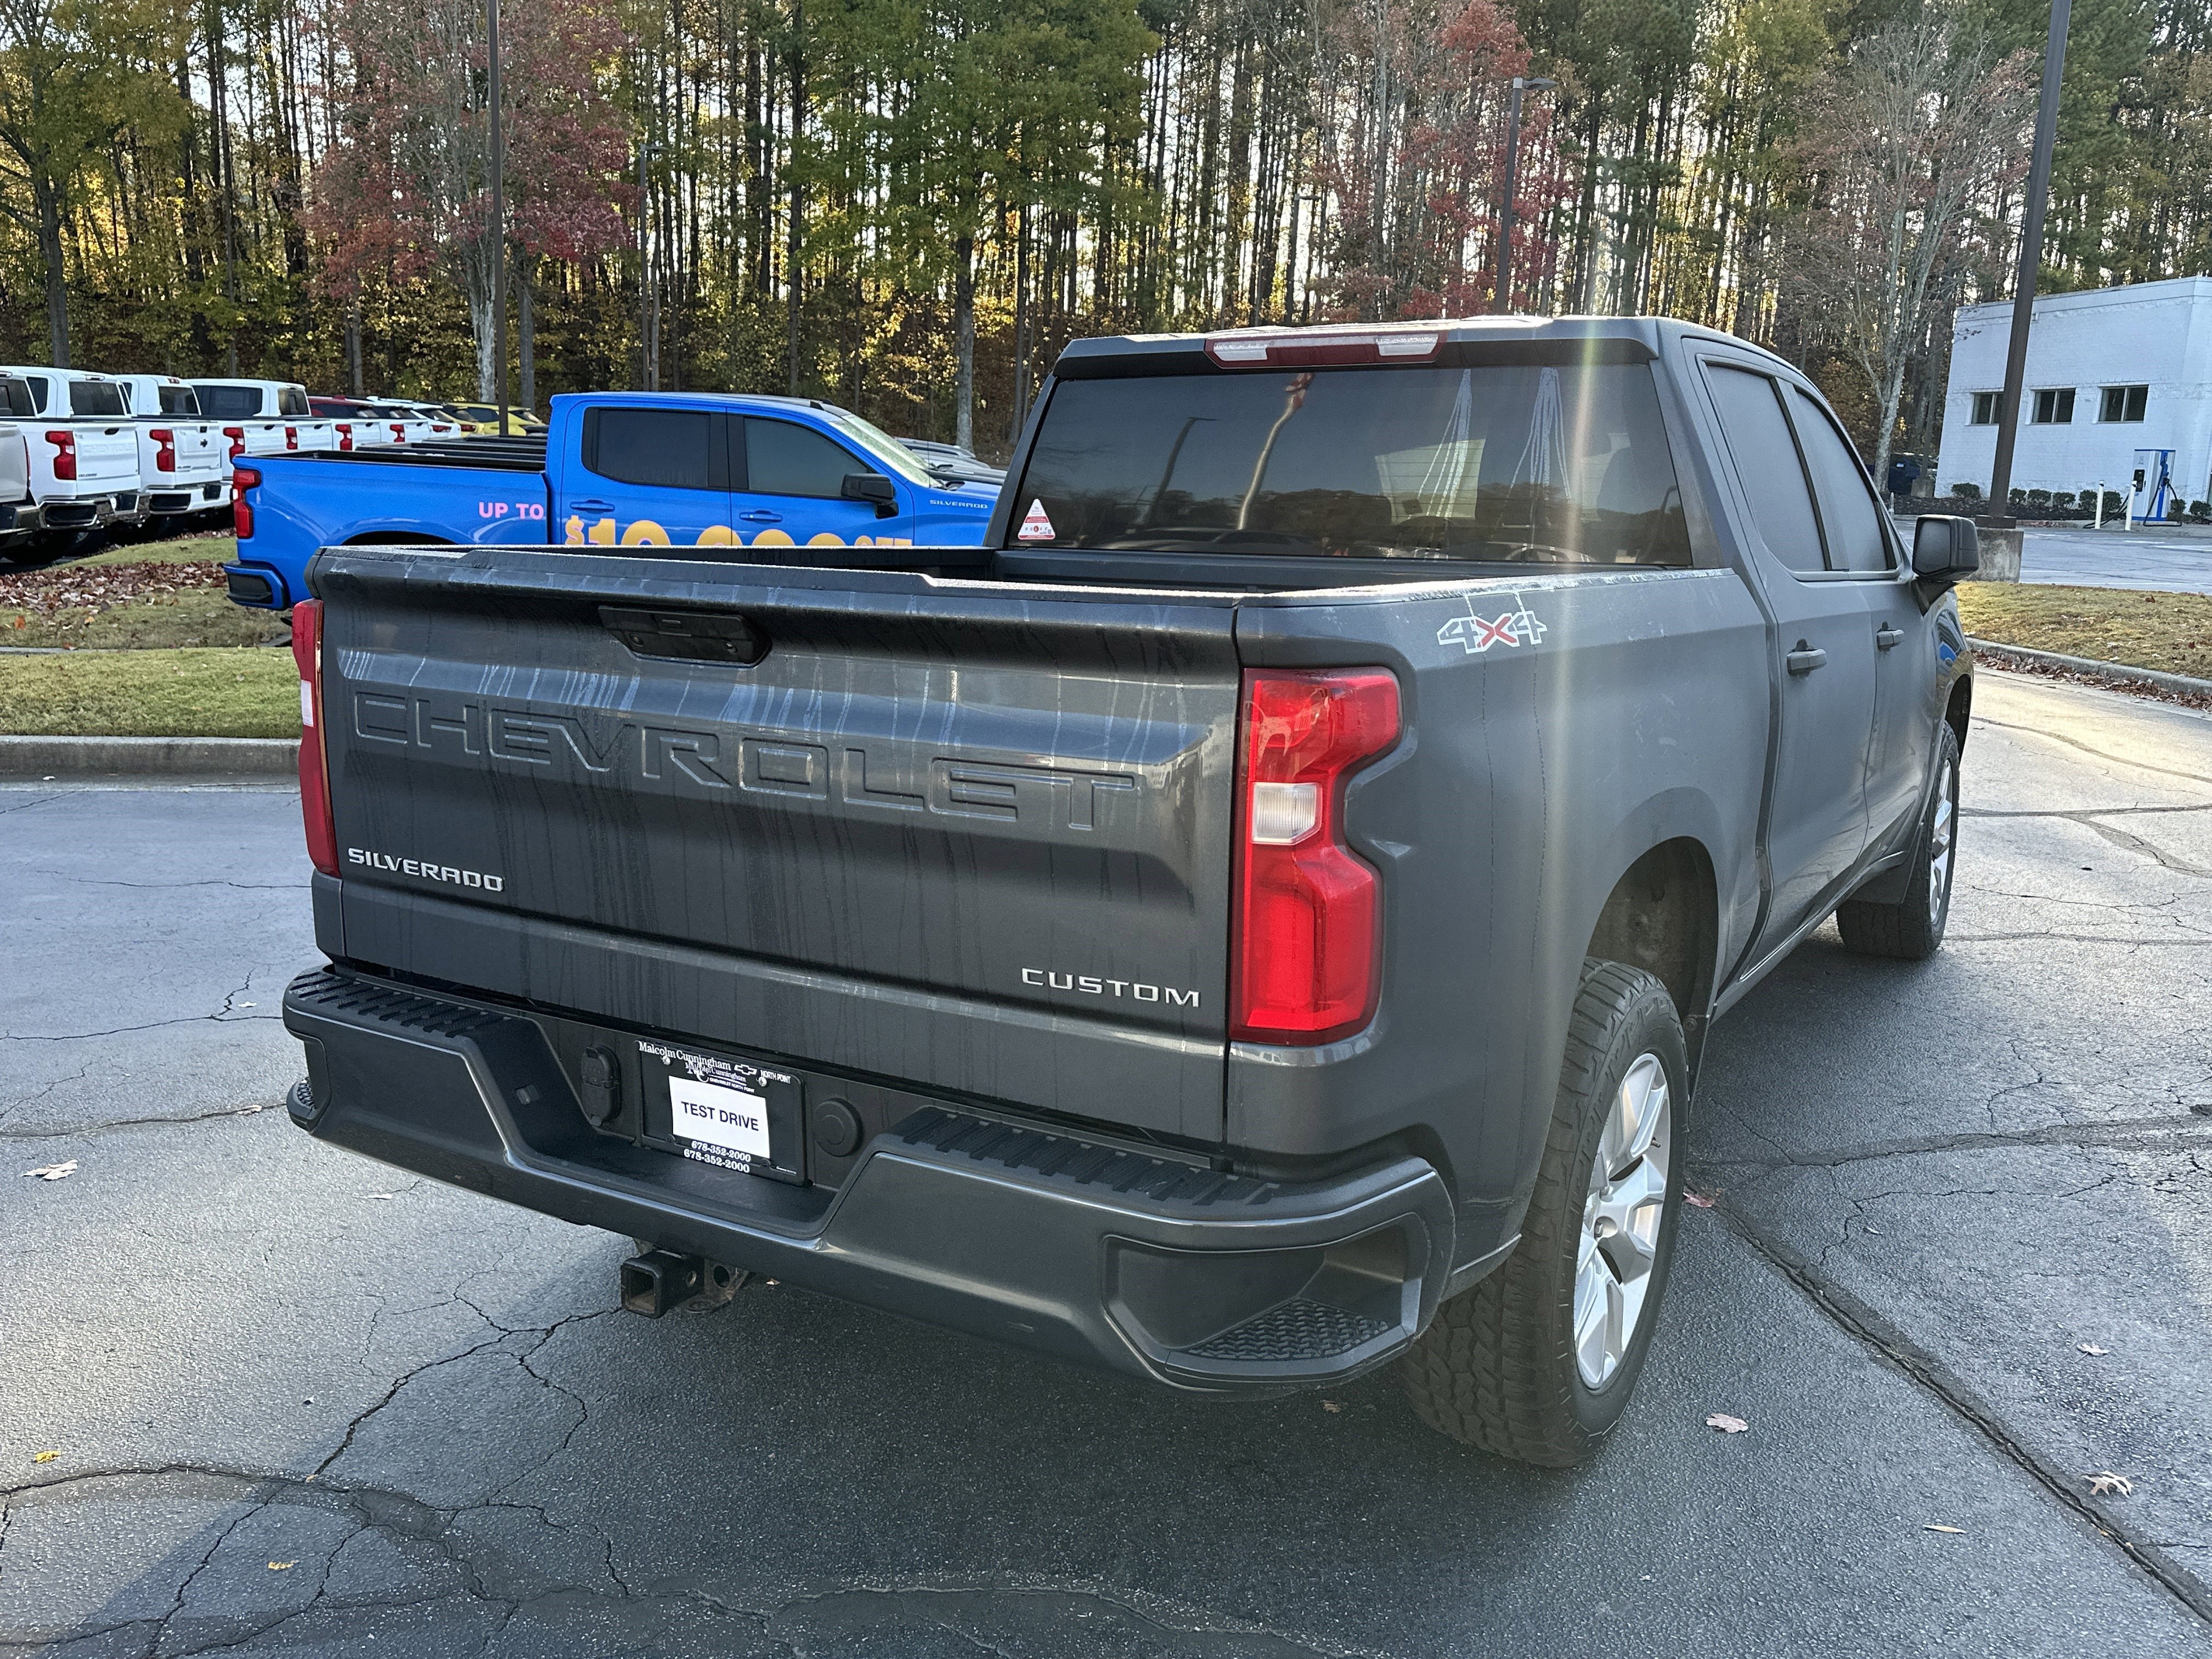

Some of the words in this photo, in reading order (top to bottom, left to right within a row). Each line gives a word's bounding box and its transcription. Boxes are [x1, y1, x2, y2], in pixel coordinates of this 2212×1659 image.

[478, 501, 509, 518] UP
[515, 503, 544, 520] TO
[929, 500, 988, 509] SILVERADO
[354, 691, 1135, 831] CHEVROLET
[348, 847, 504, 893] SILVERADO
[1022, 968, 1201, 1008] CUSTOM
[639, 1041, 676, 1059] Malcolm
[676, 1049, 732, 1070] Cunningham
[760, 1070, 777, 1081] NORTH
[777, 1073, 791, 1084] POINT
[681, 1101, 715, 1120] TEST
[719, 1109, 759, 1131] DRIVE
[684, 1148, 750, 1173] 678-352-2000
[691, 1140, 751, 1163] 678-352-2000
